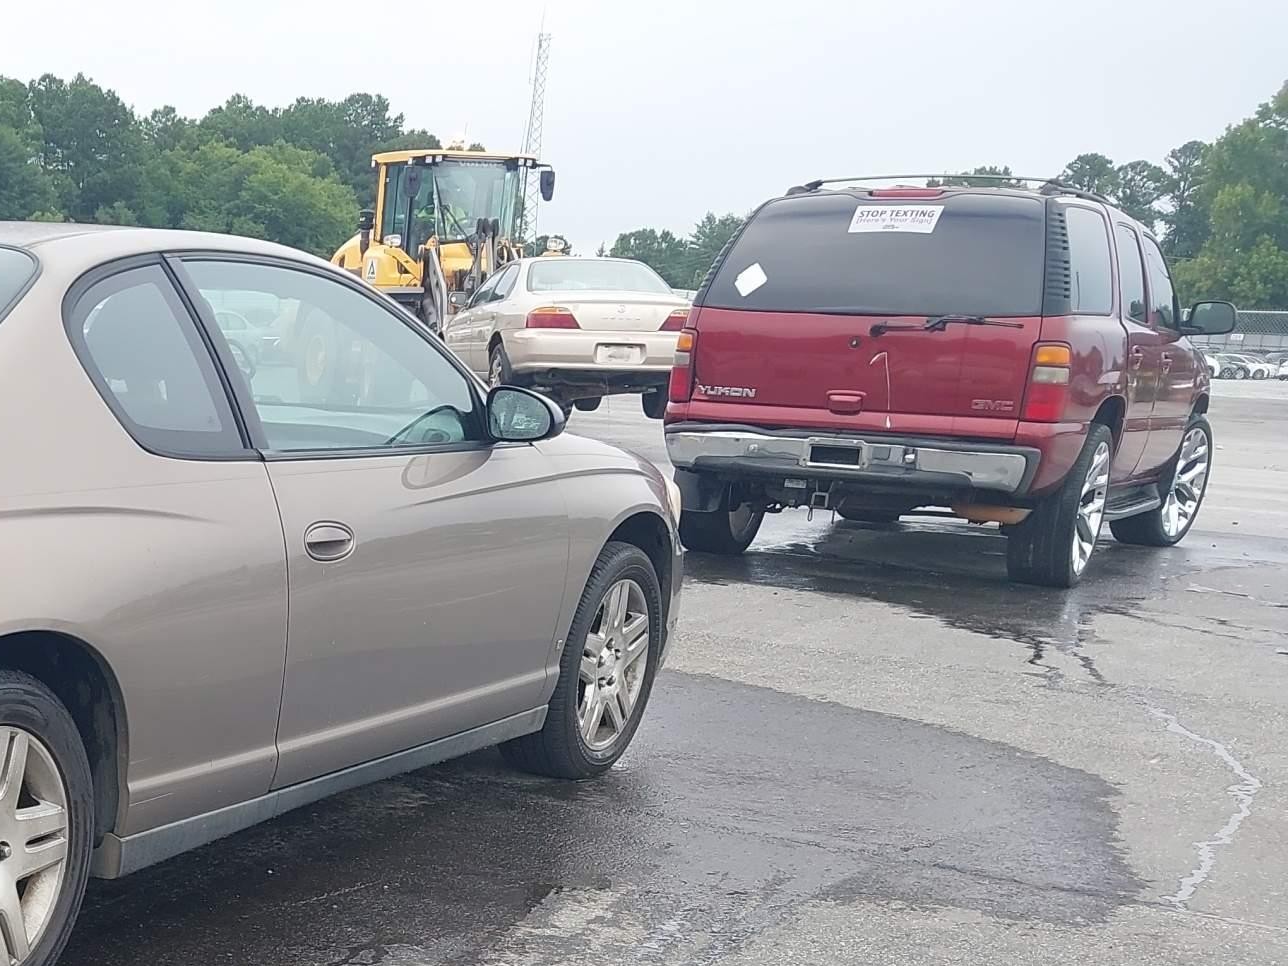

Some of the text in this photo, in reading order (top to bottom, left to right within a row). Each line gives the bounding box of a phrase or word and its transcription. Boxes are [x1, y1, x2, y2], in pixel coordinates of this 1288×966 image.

[859, 210, 936, 218] STOP TEXTING
[698, 384, 757, 398] YUKON
[971, 399, 1014, 411] GMC
